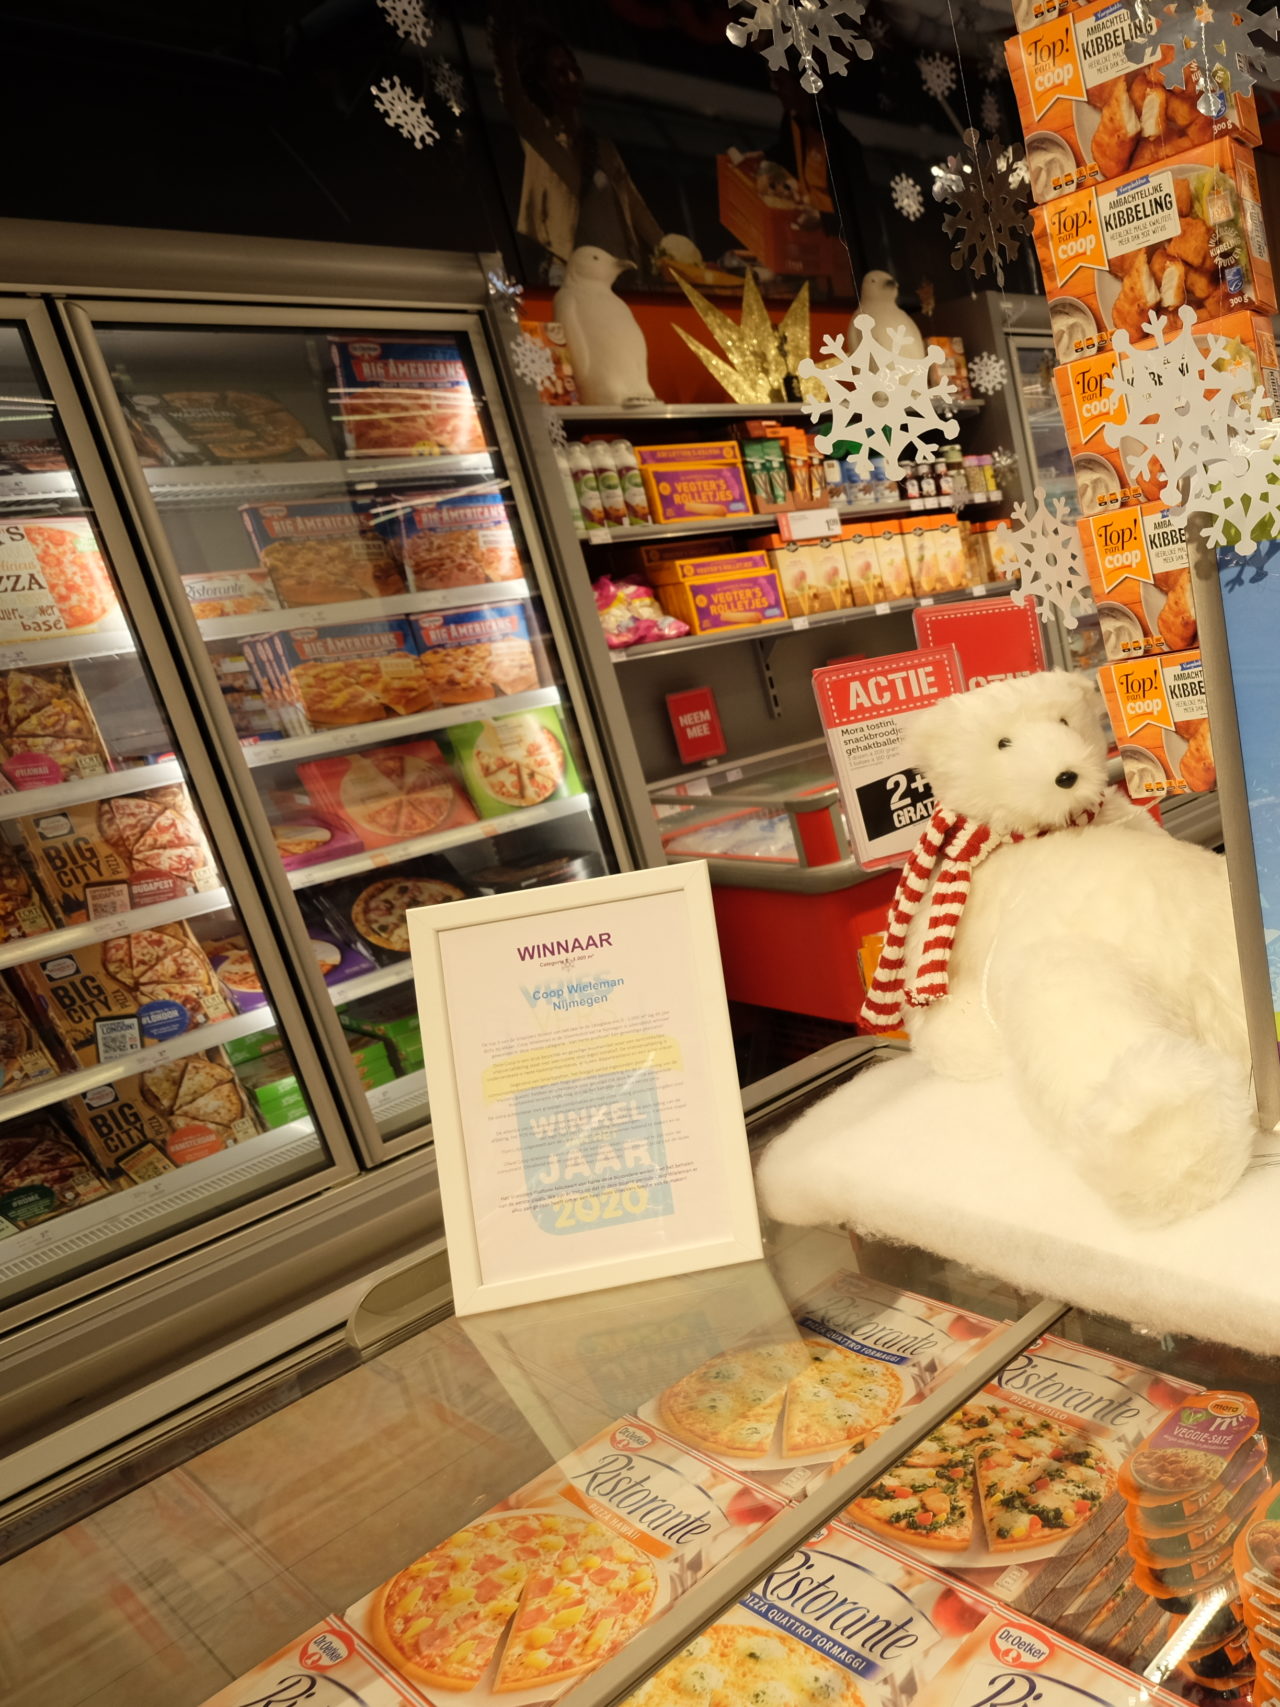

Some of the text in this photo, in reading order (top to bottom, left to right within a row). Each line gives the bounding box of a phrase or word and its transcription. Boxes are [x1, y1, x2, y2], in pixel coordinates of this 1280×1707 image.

[1086, 11, 1130, 36] AMBACHTELI
[1027, 27, 1070, 65] Top!
[1081, 17, 1153, 60] KIBBELING
[1034, 63, 1074, 91] coop
[1108, 182, 1163, 210] AMBACHTELIJKE
[1051, 199, 1092, 237] Top!
[1104, 193, 1173, 232] KIBBELING
[1058, 234, 1096, 260] coop
[1229, 296, 1242, 307] 300
[361, 358, 464, 379] BIG AMERICANS
[1081, 396, 1118, 418] coop
[673, 490, 735, 505] ROLLETJES
[674, 479, 727, 494] VEGTER'S
[296, 513, 369, 531] AMERICANS
[441, 505, 505, 523] AMERICANS
[1098, 518, 1138, 550] Top!
[1149, 528, 1186, 549] KIBBE
[1104, 549, 1141, 568] coop
[710, 587, 762, 603] VEGTER'S
[710, 598, 769, 615] ROLLETJES
[20, 619, 63, 633] base
[450, 620, 513, 639] AMERICANS
[326, 632, 397, 650] AMERICANS
[849, 665, 938, 711] ACTIE
[1119, 669, 1158, 699] Top!
[1169, 681, 1205, 700] KIBBE
[678, 709, 712, 728] NEEM
[1126, 698, 1162, 716] coop
[686, 722, 711, 739] MEE
[841, 719, 897, 737] Mora tostini,
[893, 800, 934, 829] GRAT
[44, 836, 99, 872] BIG
[56, 861, 104, 889] CITY
[517, 932, 613, 962] WINNAAR
[51, 974, 105, 1010] BIG
[532, 977, 625, 1001] Coop Wieleman
[64, 1000, 114, 1026] CITY
[552, 994, 609, 1012] Nijmegen
[90, 1102, 142, 1139] BIG
[528, 1099, 648, 1139] WINKEL
[104, 1128, 149, 1155] CITY
[539, 1138, 654, 1184] JAAR
[554, 1183, 649, 1228] 2020
[804, 1295, 939, 1357] Ristorante
[860, 1346, 901, 1364] FORMAGGI
[996, 1353, 1141, 1427] Ristorante
[1009, 1394, 1070, 1421] PIZZA POLLO
[1213, 1402, 1239, 1413] mora
[1173, 1425, 1234, 1445] VEGGIE-SATÉ
[572, 1453, 712, 1546] Ristorante
[588, 1502, 642, 1541] PIZZA HAWAII
[760, 1549, 920, 1661] Ristorante
[767, 1605, 813, 1642] QUATTRO
[811, 1632, 868, 1672] FORMAGGI
[998, 1630, 1049, 1662] Dr.Oetker
